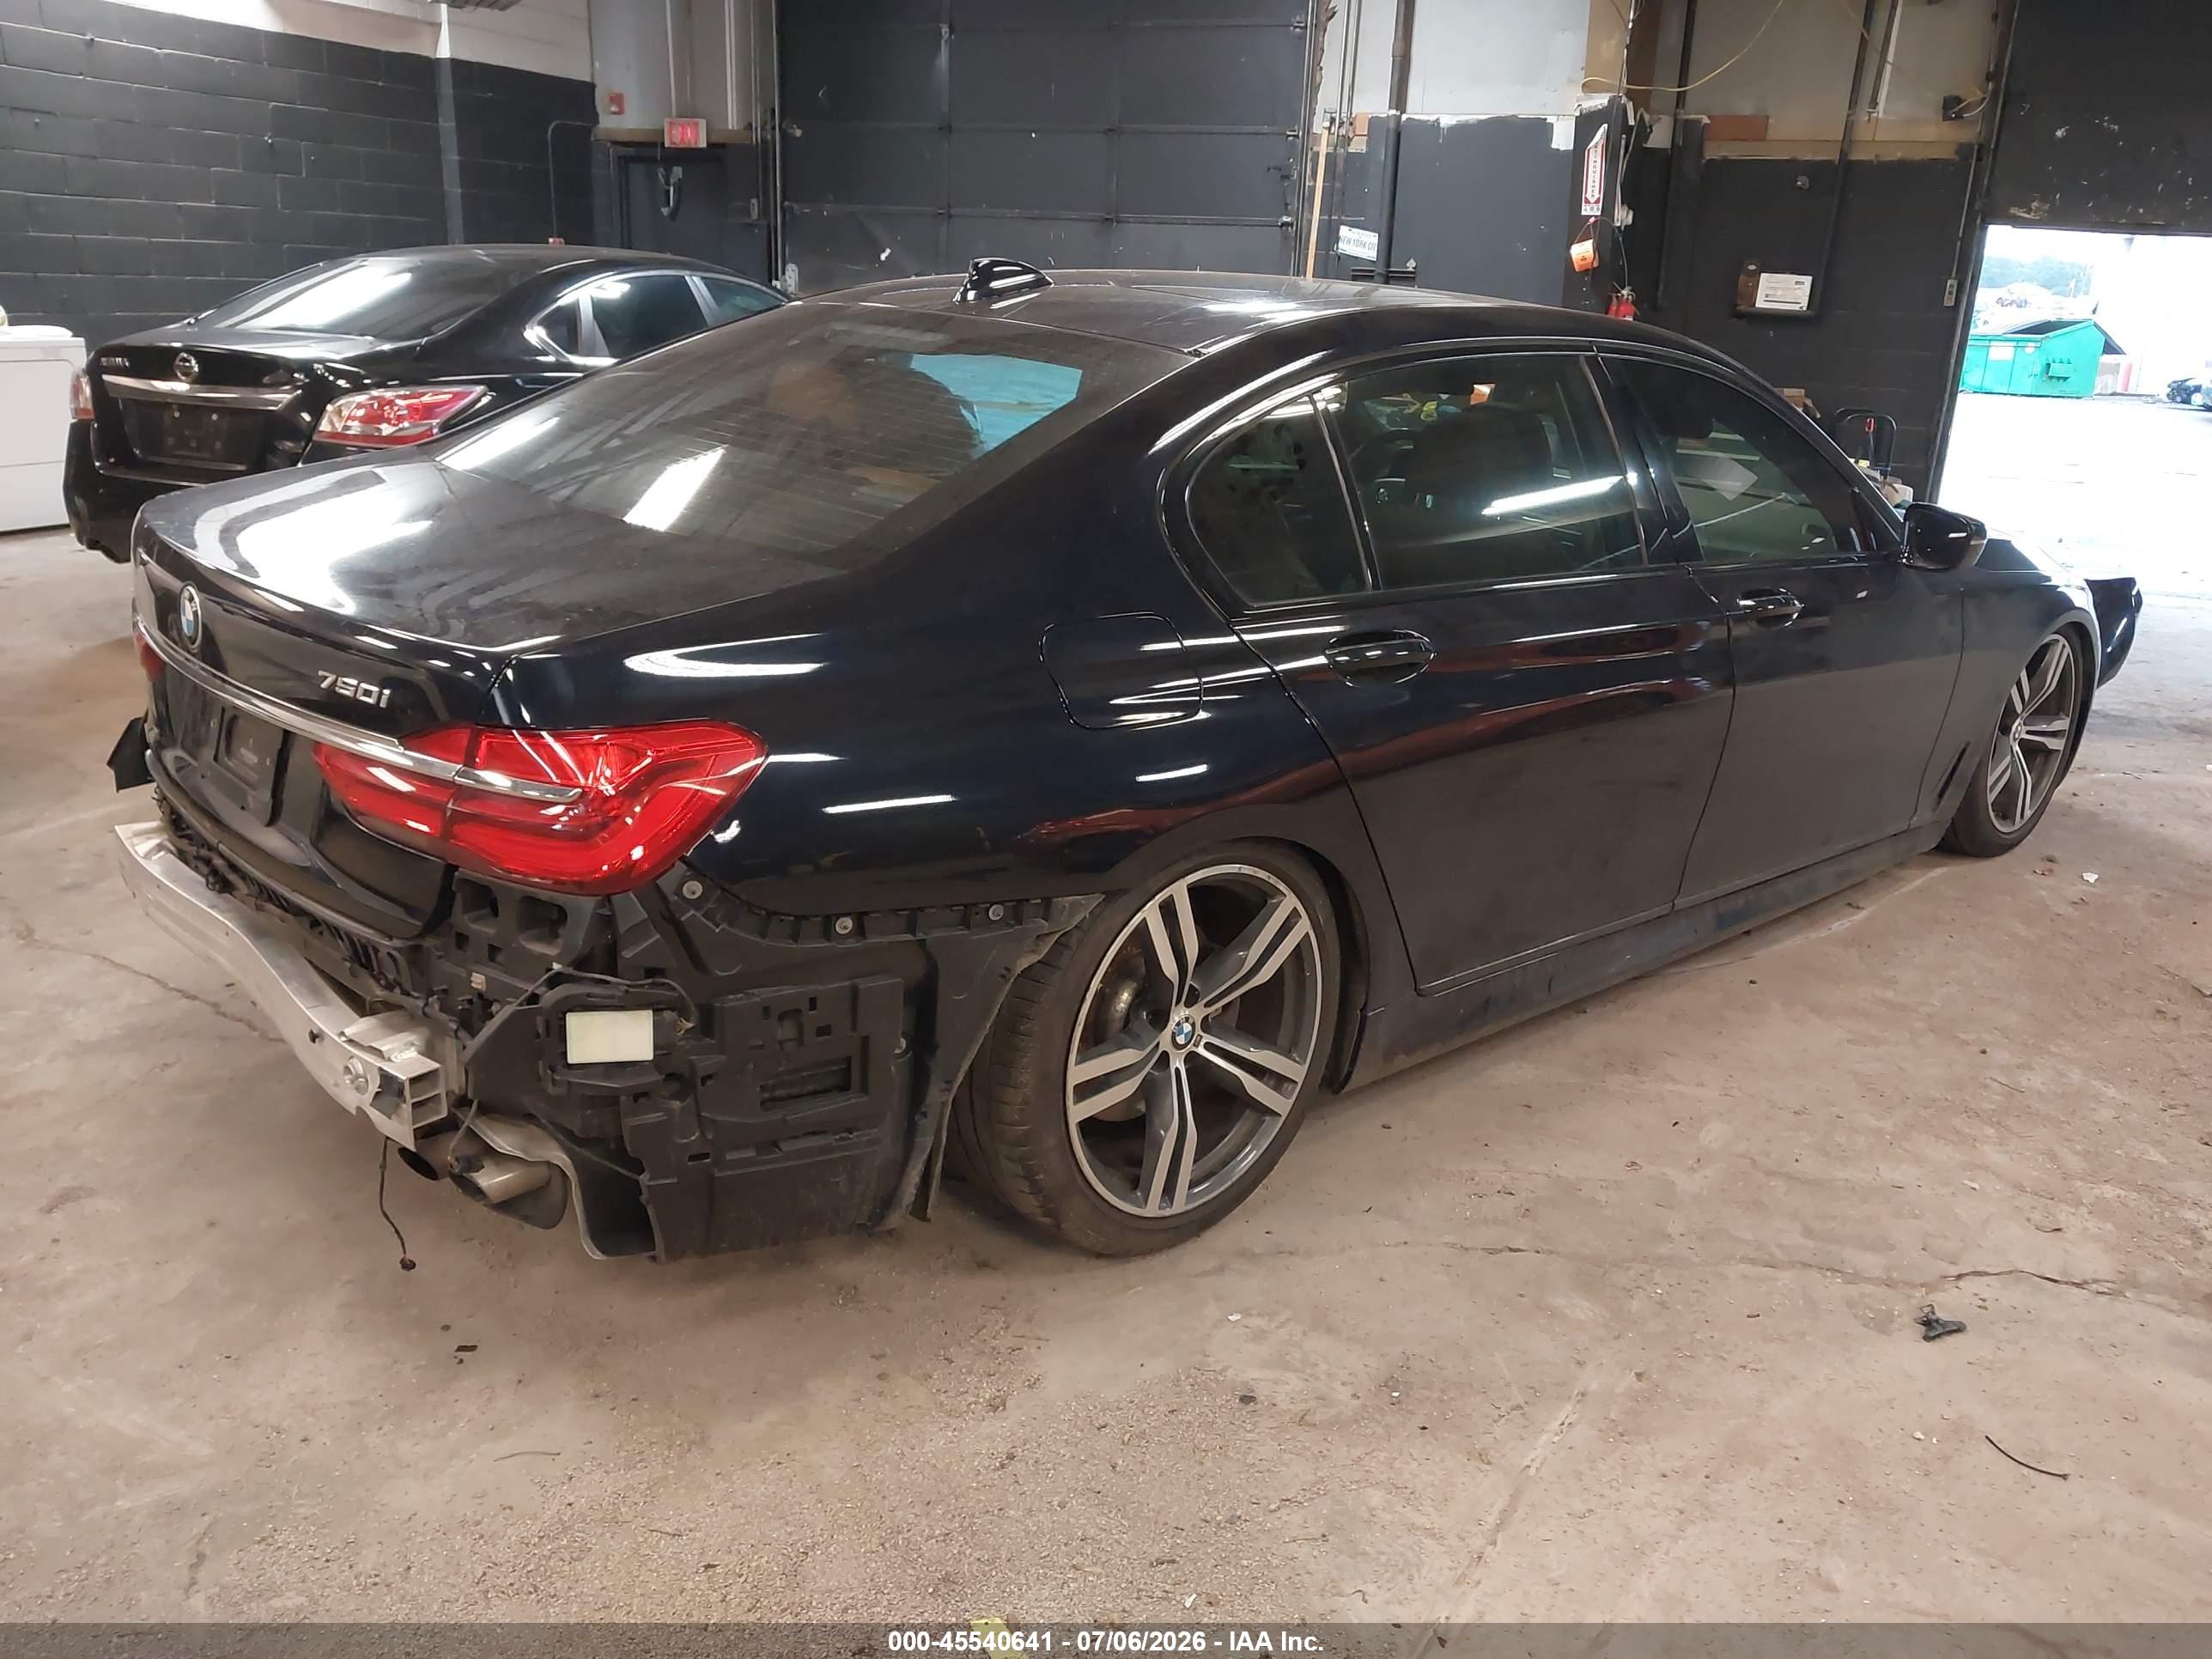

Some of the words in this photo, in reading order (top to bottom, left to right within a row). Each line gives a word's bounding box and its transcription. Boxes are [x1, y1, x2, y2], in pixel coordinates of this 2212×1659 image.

[1340, 235, 1352, 246] NEW
[1353, 239, 1367, 249] YORK
[1368, 241, 1376, 252] CIT
[317, 669, 391, 708] 750i
